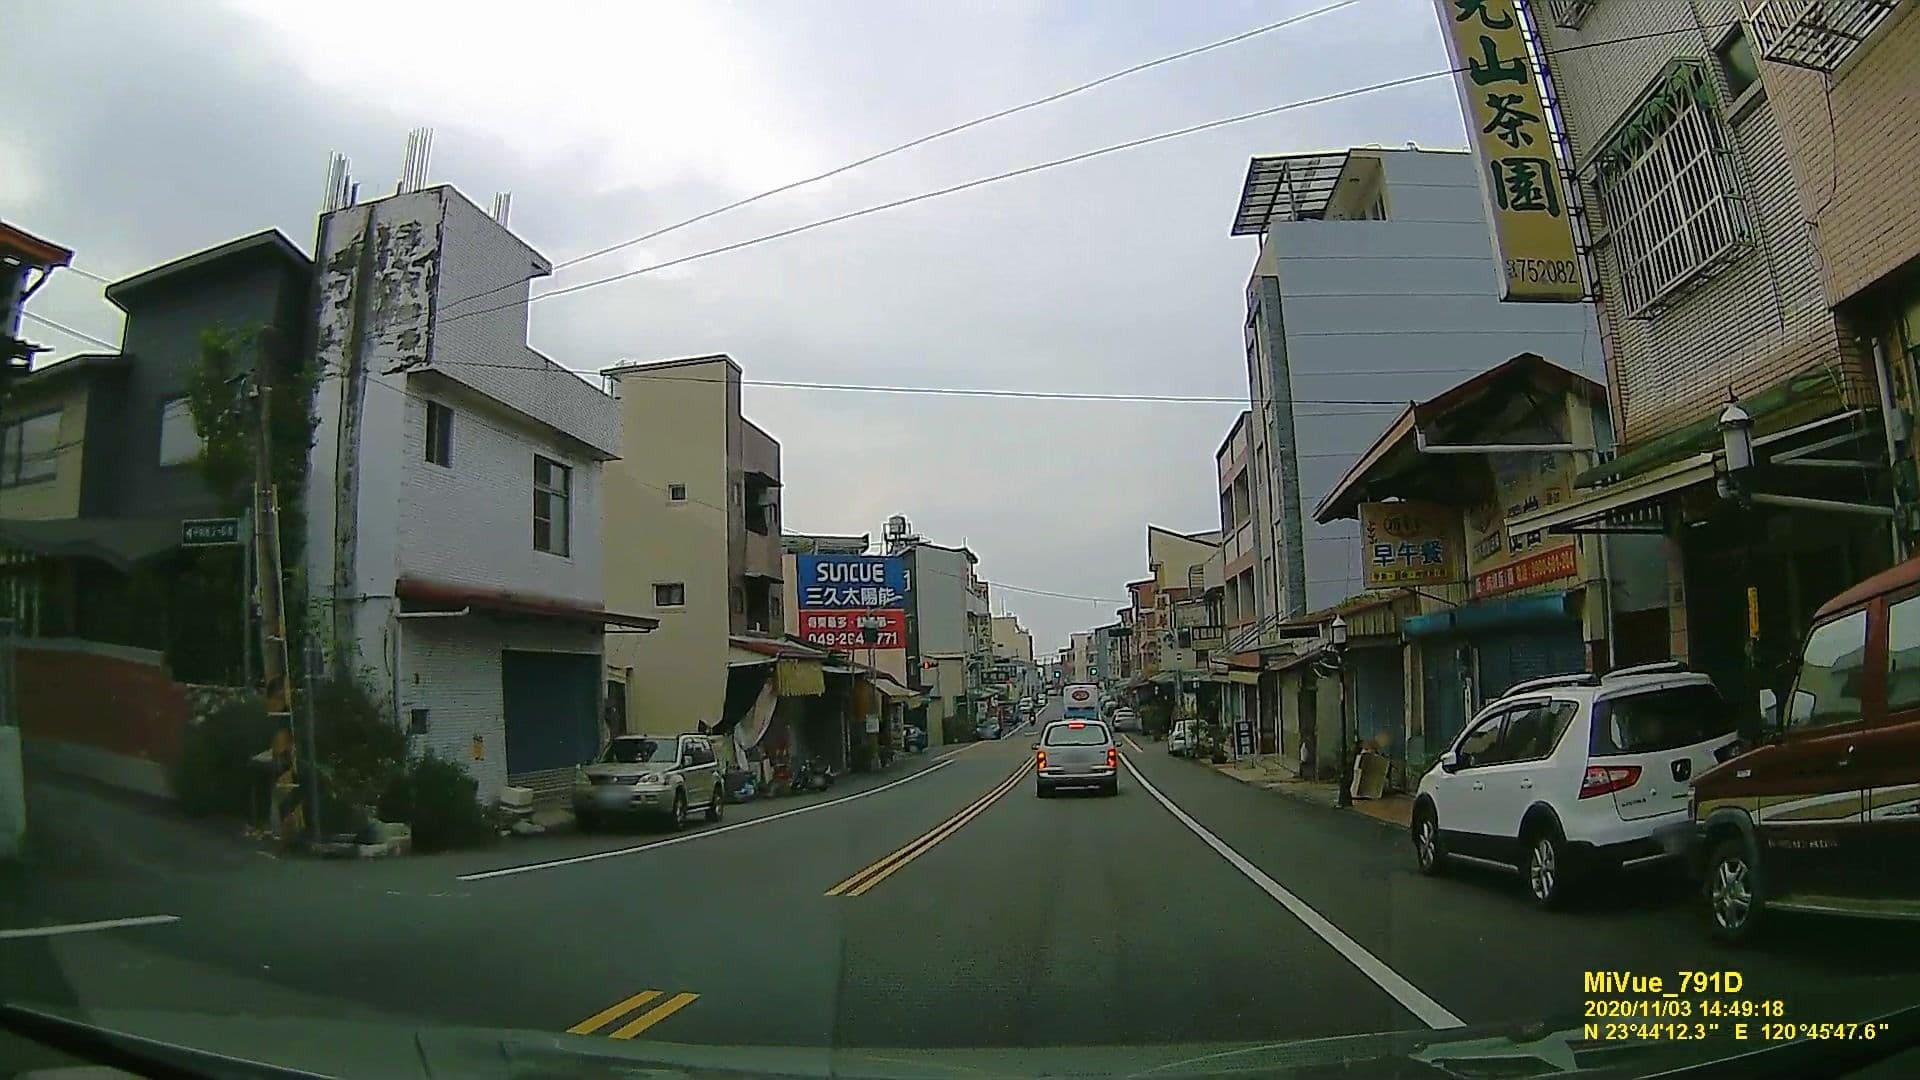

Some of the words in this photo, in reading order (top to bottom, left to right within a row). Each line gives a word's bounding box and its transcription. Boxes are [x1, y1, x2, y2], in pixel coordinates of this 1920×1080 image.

[1373, 539, 1442, 567] 早午餐
[816, 562, 885, 583] SUNCUE
[806, 587, 903, 606] 三久太陽能
[808, 632, 898, 646] 049-264771
